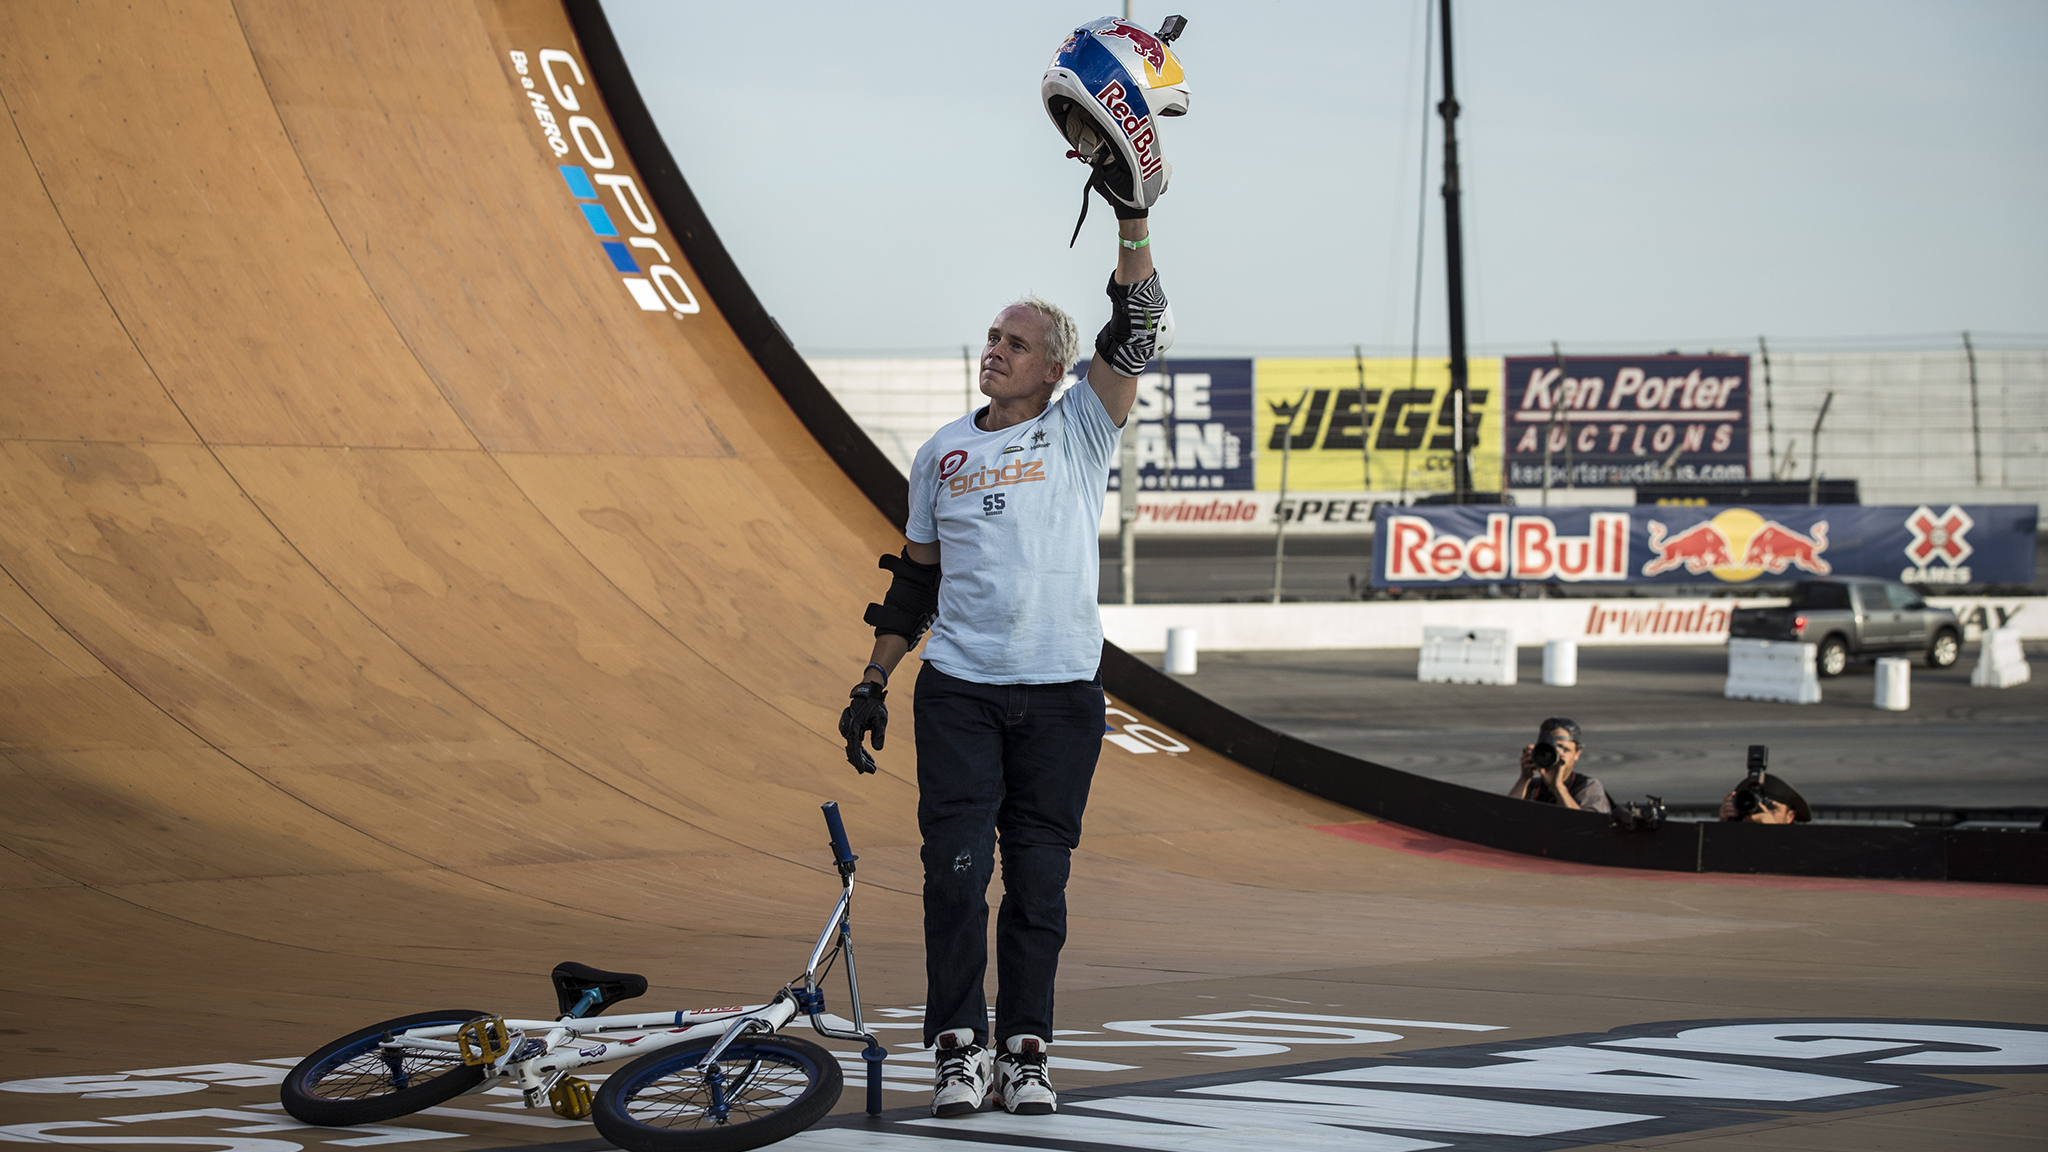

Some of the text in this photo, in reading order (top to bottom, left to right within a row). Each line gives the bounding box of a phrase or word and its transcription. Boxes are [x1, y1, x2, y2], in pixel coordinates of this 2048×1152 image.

[509, 49, 529, 75] Be
[1096, 79, 1163, 182] Red Bull
[1521, 366, 1742, 410] Ken Porter
[1267, 388, 1489, 451] JEGS
[1516, 423, 1734, 453] AUCTIONS
[948, 458, 1046, 498] grindz
[1135, 499, 1259, 523] rwindale
[1386, 513, 1630, 581] Red Bull
[1900, 566, 1973, 585] GAMES
